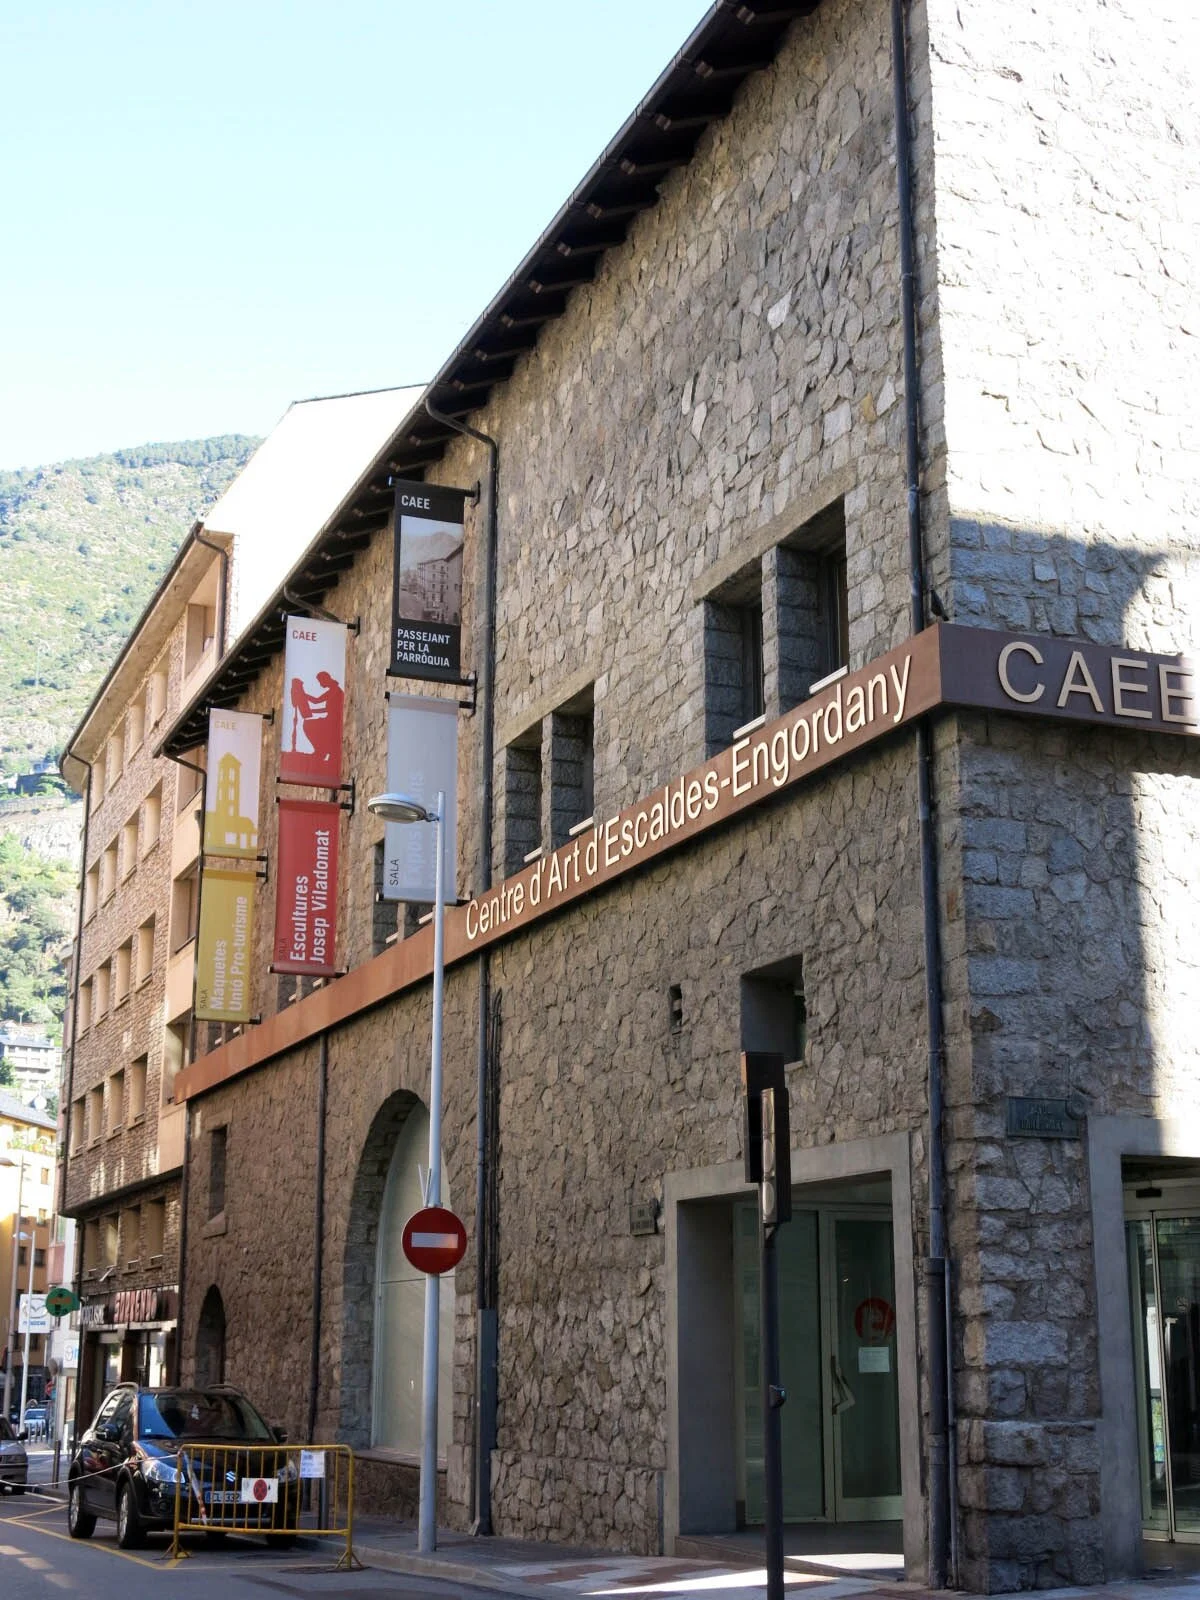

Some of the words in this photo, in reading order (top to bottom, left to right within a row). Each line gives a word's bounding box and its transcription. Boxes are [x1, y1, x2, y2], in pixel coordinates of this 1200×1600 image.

[401, 495, 430, 509] CAEE
[292, 630, 317, 641] CAEE
[397, 640, 415, 651] PER
[418, 643, 429, 653] LA
[398, 629, 450, 644] PASSEJANT
[397, 651, 450, 667] PARRÒQUIA
[998, 641, 1198, 726] CAEE
[312, 830, 330, 910] Viladomat
[390, 858, 399, 886] SALA
[466, 881, 525, 940] Centre
[530, 846, 581, 904] d'Art
[290, 875, 308, 961] Escultures
[231, 896, 247, 975] Pro-turisme
[310, 917, 329, 964] Josep
[210, 939, 226, 1010] Maquetes
[200, 989, 208, 1008] SALA
[229, 980, 243, 1011] Unió
